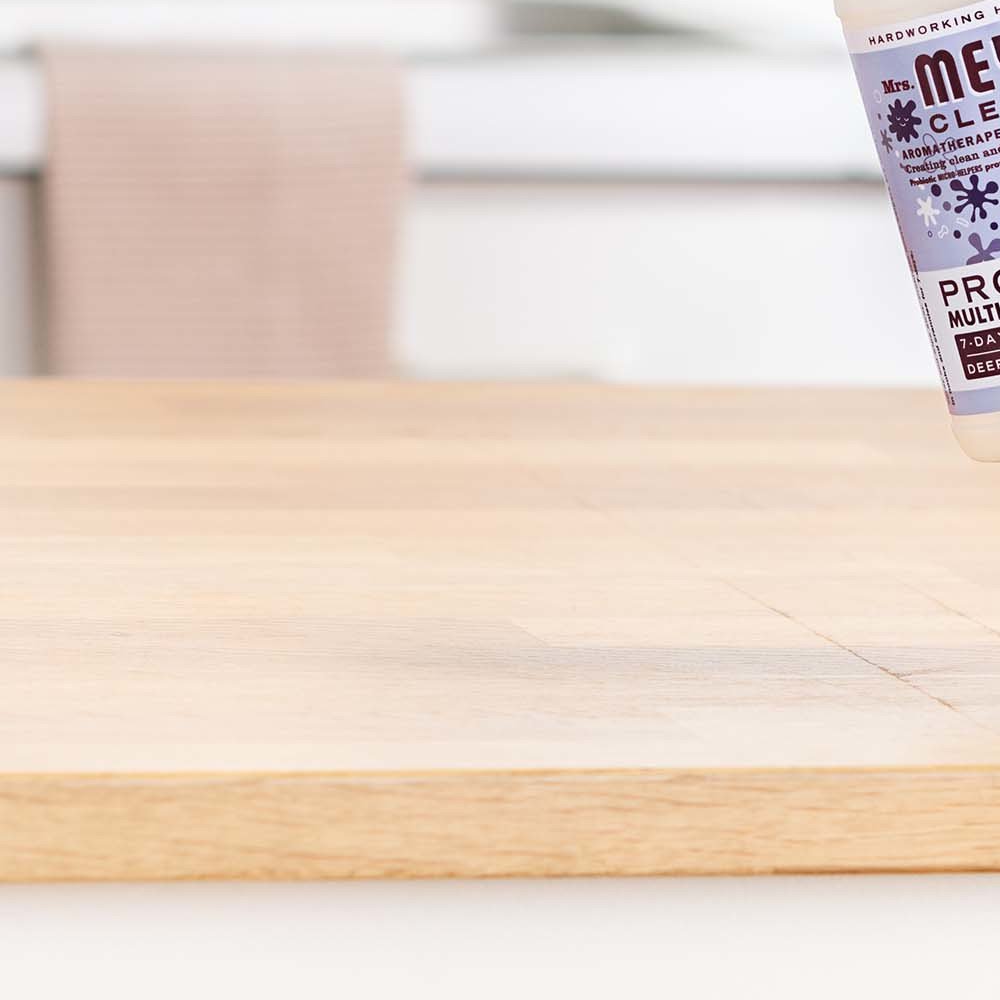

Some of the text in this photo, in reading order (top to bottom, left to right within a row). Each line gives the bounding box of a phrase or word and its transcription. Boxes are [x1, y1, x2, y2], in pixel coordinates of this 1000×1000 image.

[868, 10, 985, 46] HARDWORKING
[882, 79, 915, 95] Mrs.
[904, 159, 947, 174] Creating
[949, 150, 980, 166] clean
